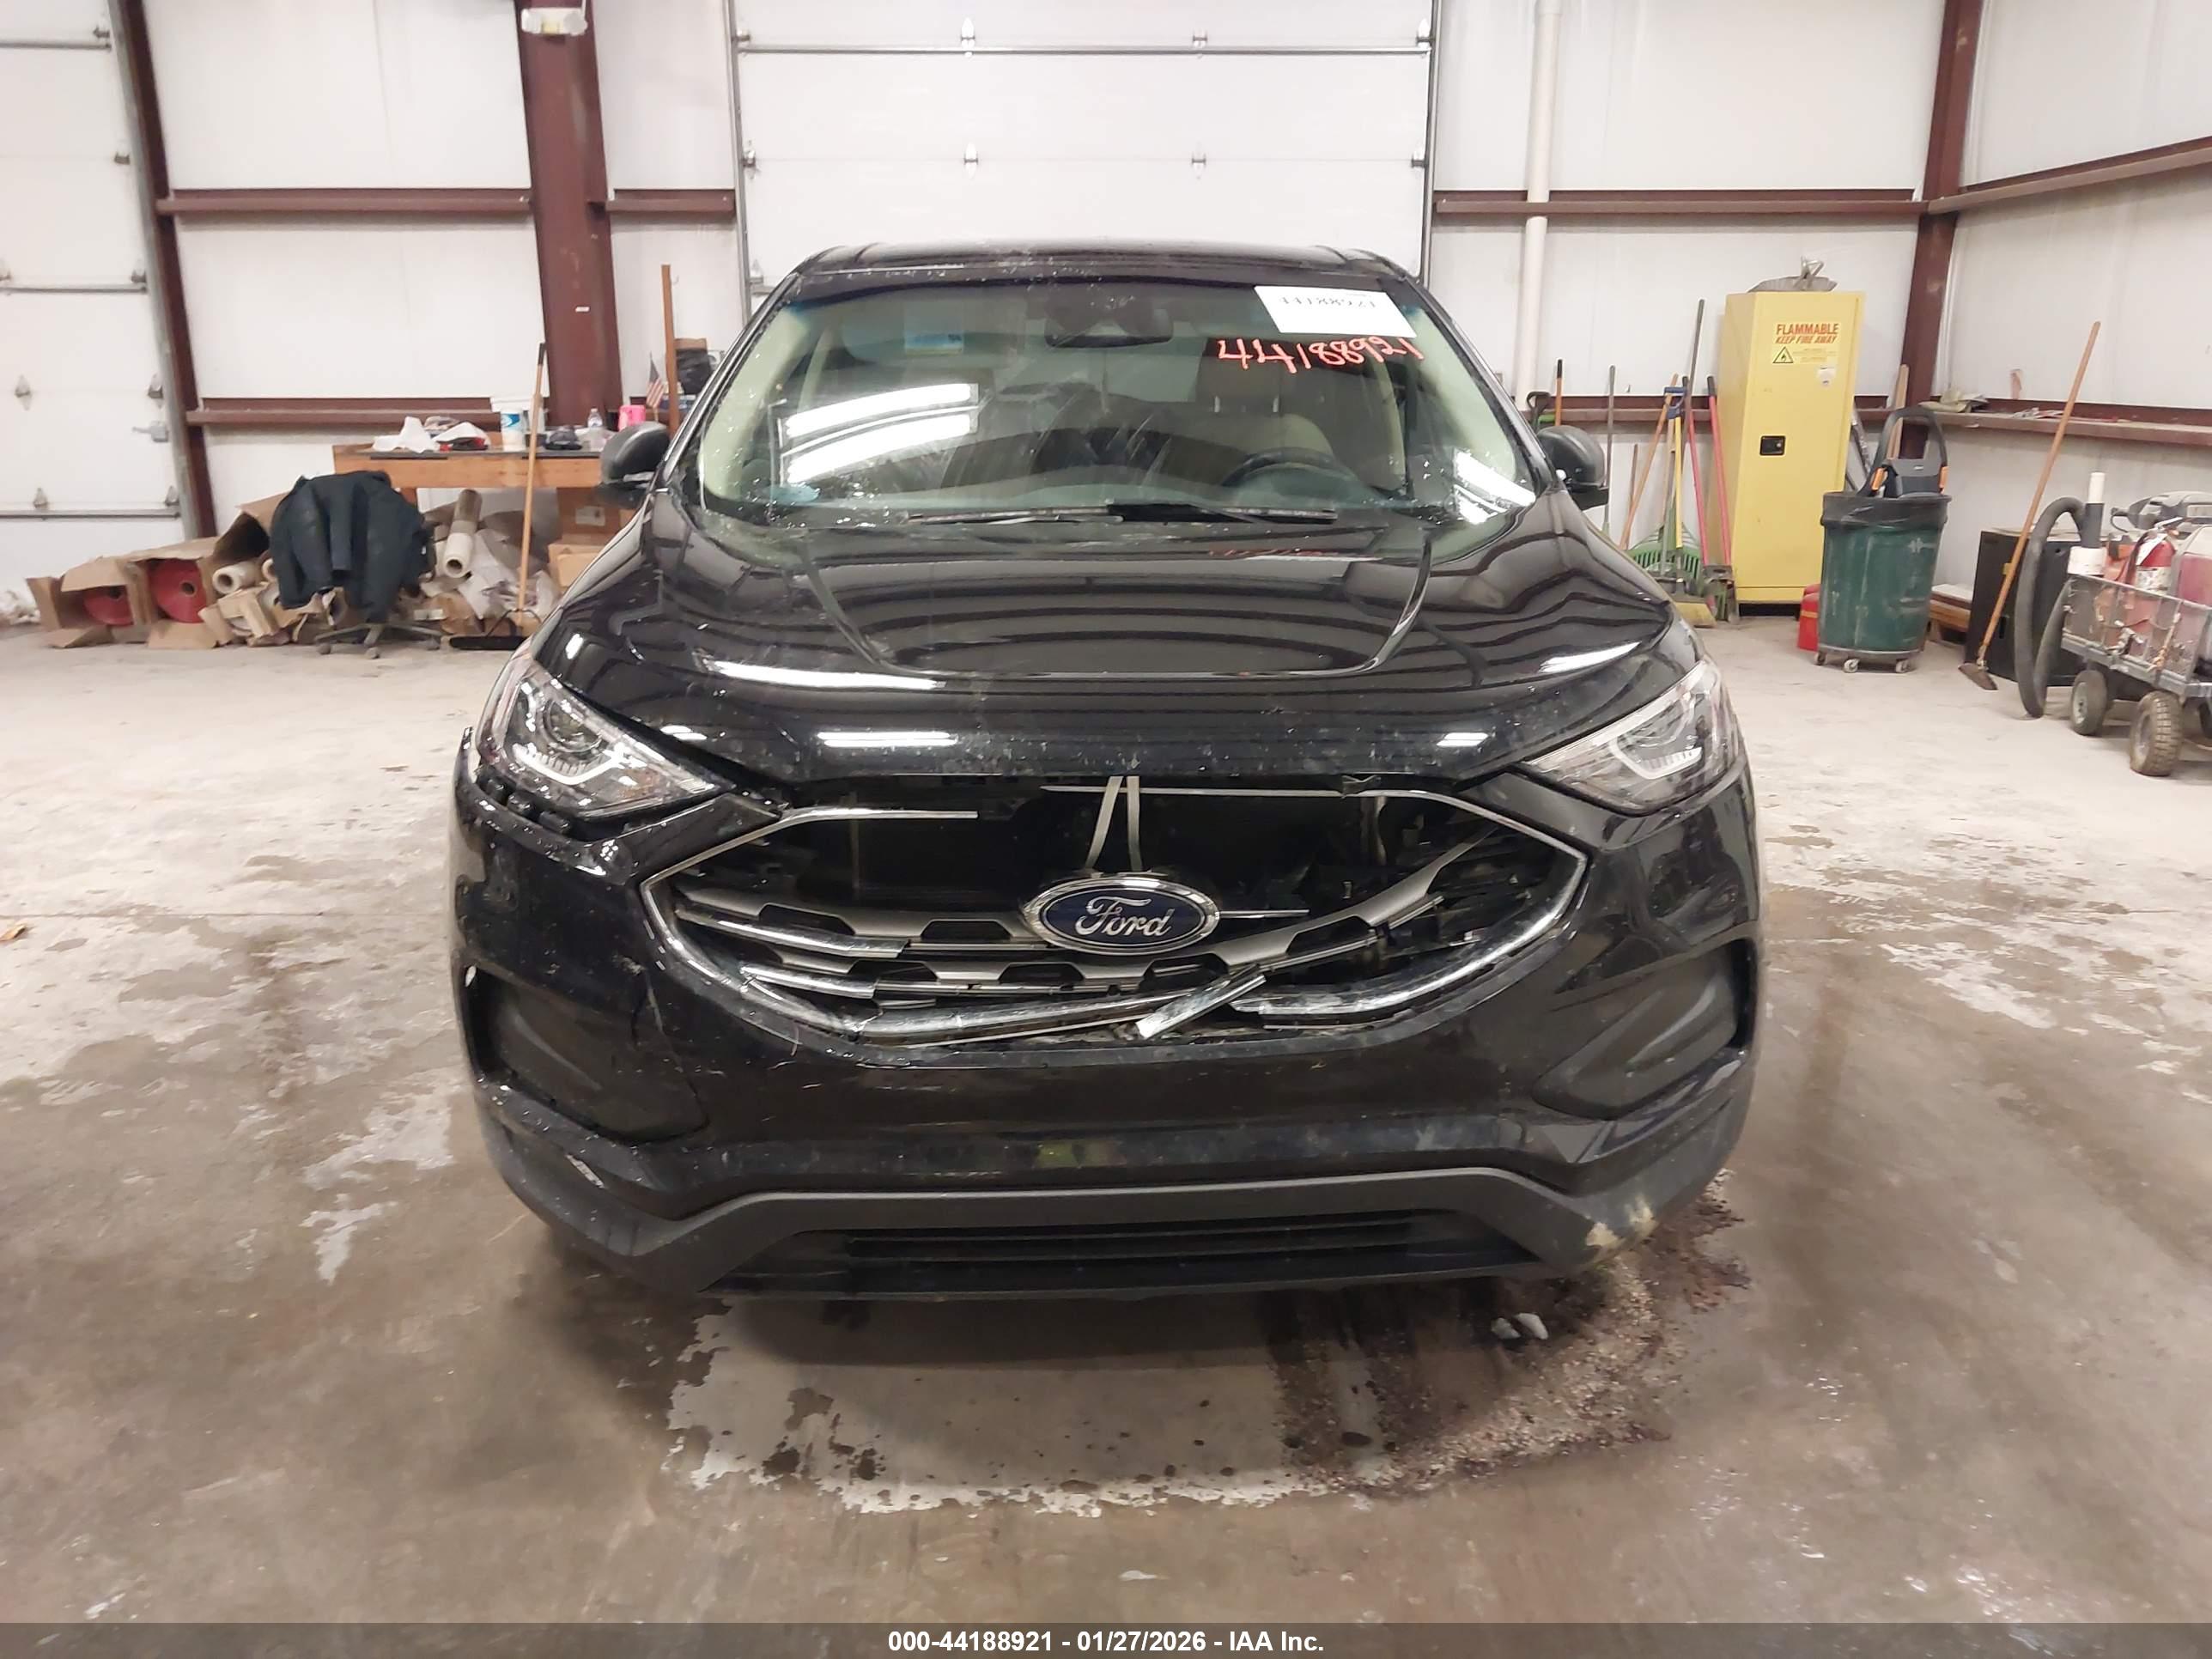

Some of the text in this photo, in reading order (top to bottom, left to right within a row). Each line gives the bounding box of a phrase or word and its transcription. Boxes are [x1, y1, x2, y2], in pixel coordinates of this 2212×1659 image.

[1774, 335, 1837, 344] KEEP FIRE AWAY
[1776, 324, 1839, 335] FLAMMABLE
[1217, 336, 1425, 374] 44188921
[1075, 896, 1176, 937] Ford
